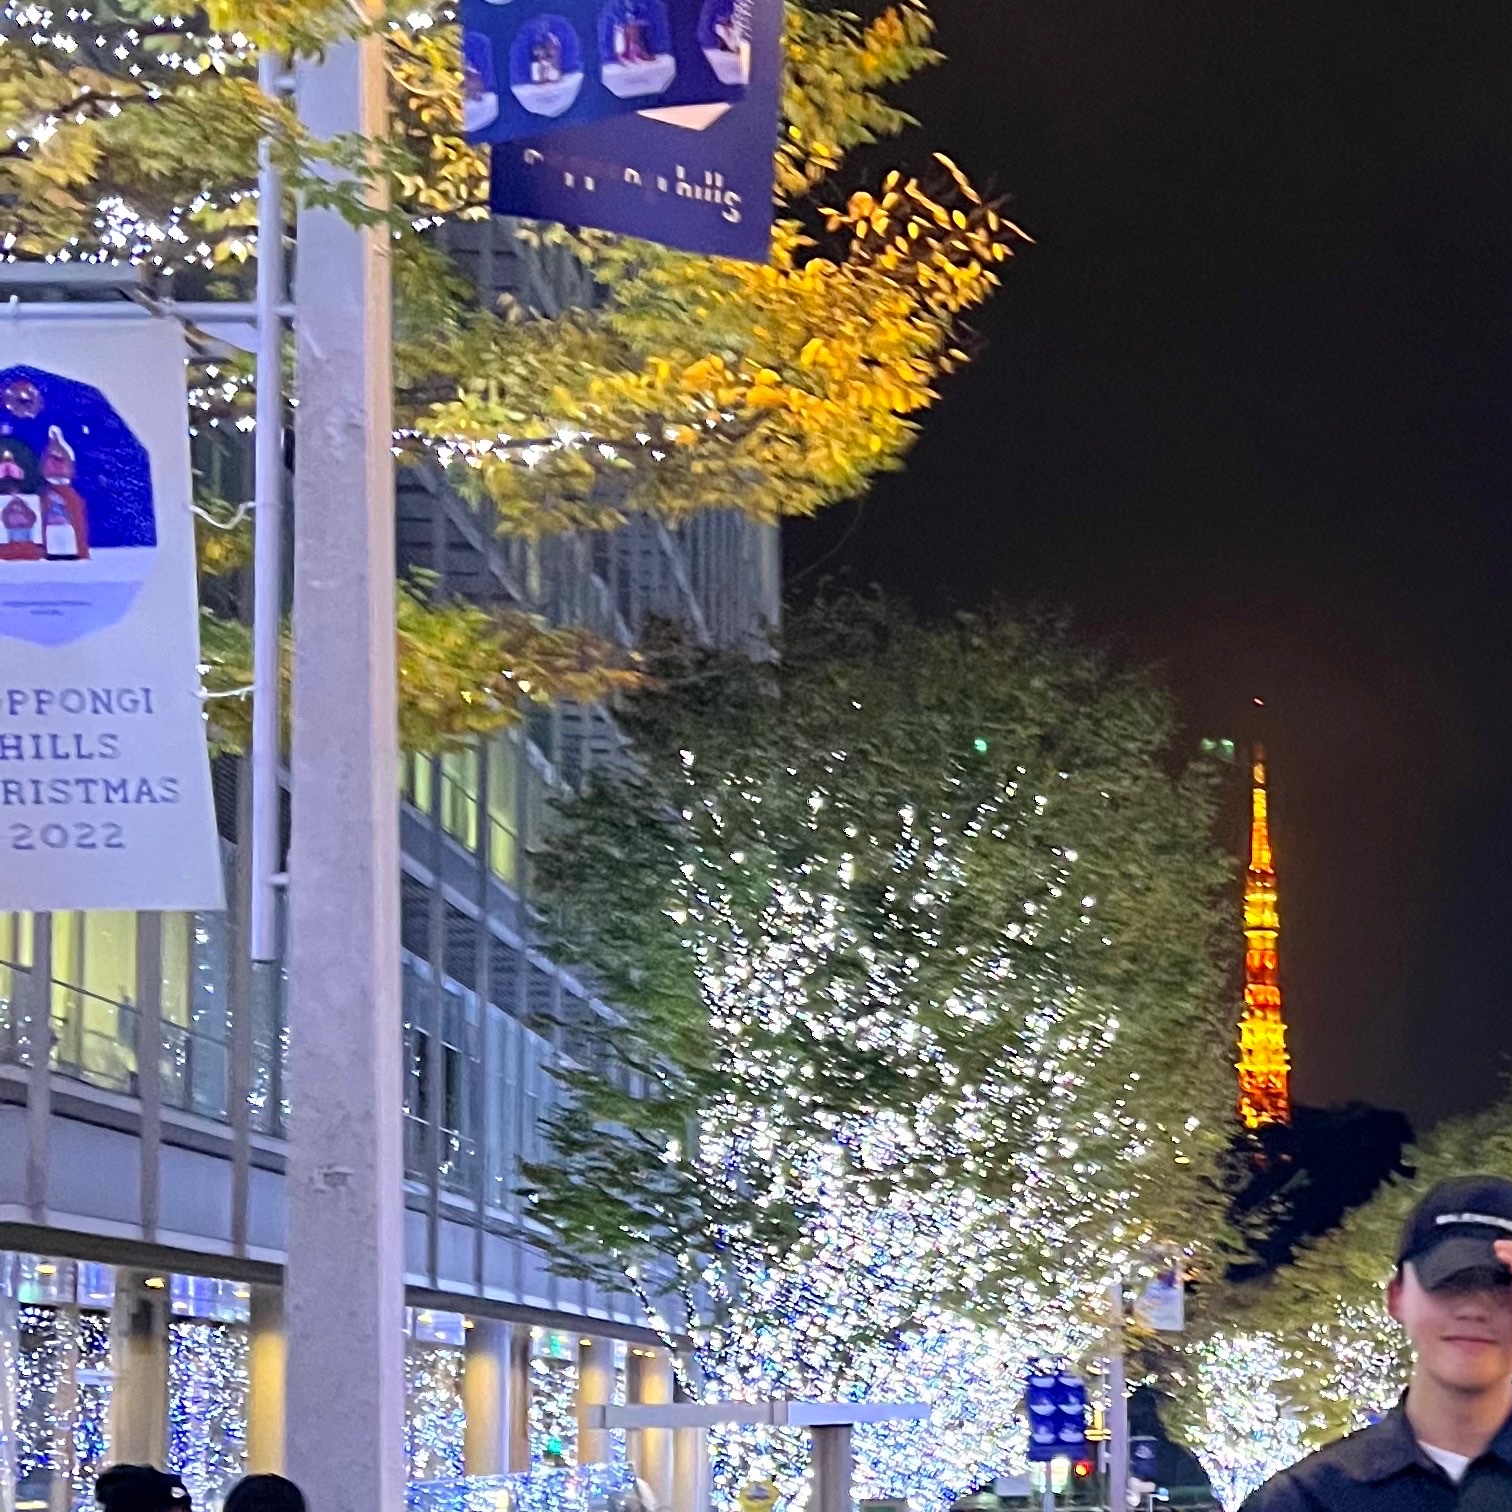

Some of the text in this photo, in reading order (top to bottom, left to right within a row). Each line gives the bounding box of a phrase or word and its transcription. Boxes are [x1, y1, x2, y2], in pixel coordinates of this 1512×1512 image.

[0, 687, 154, 715] PPONGI
[0, 733, 120, 760] HILLS
[0, 776, 180, 805] RISTMAS
[9, 822, 126, 850] 2022
